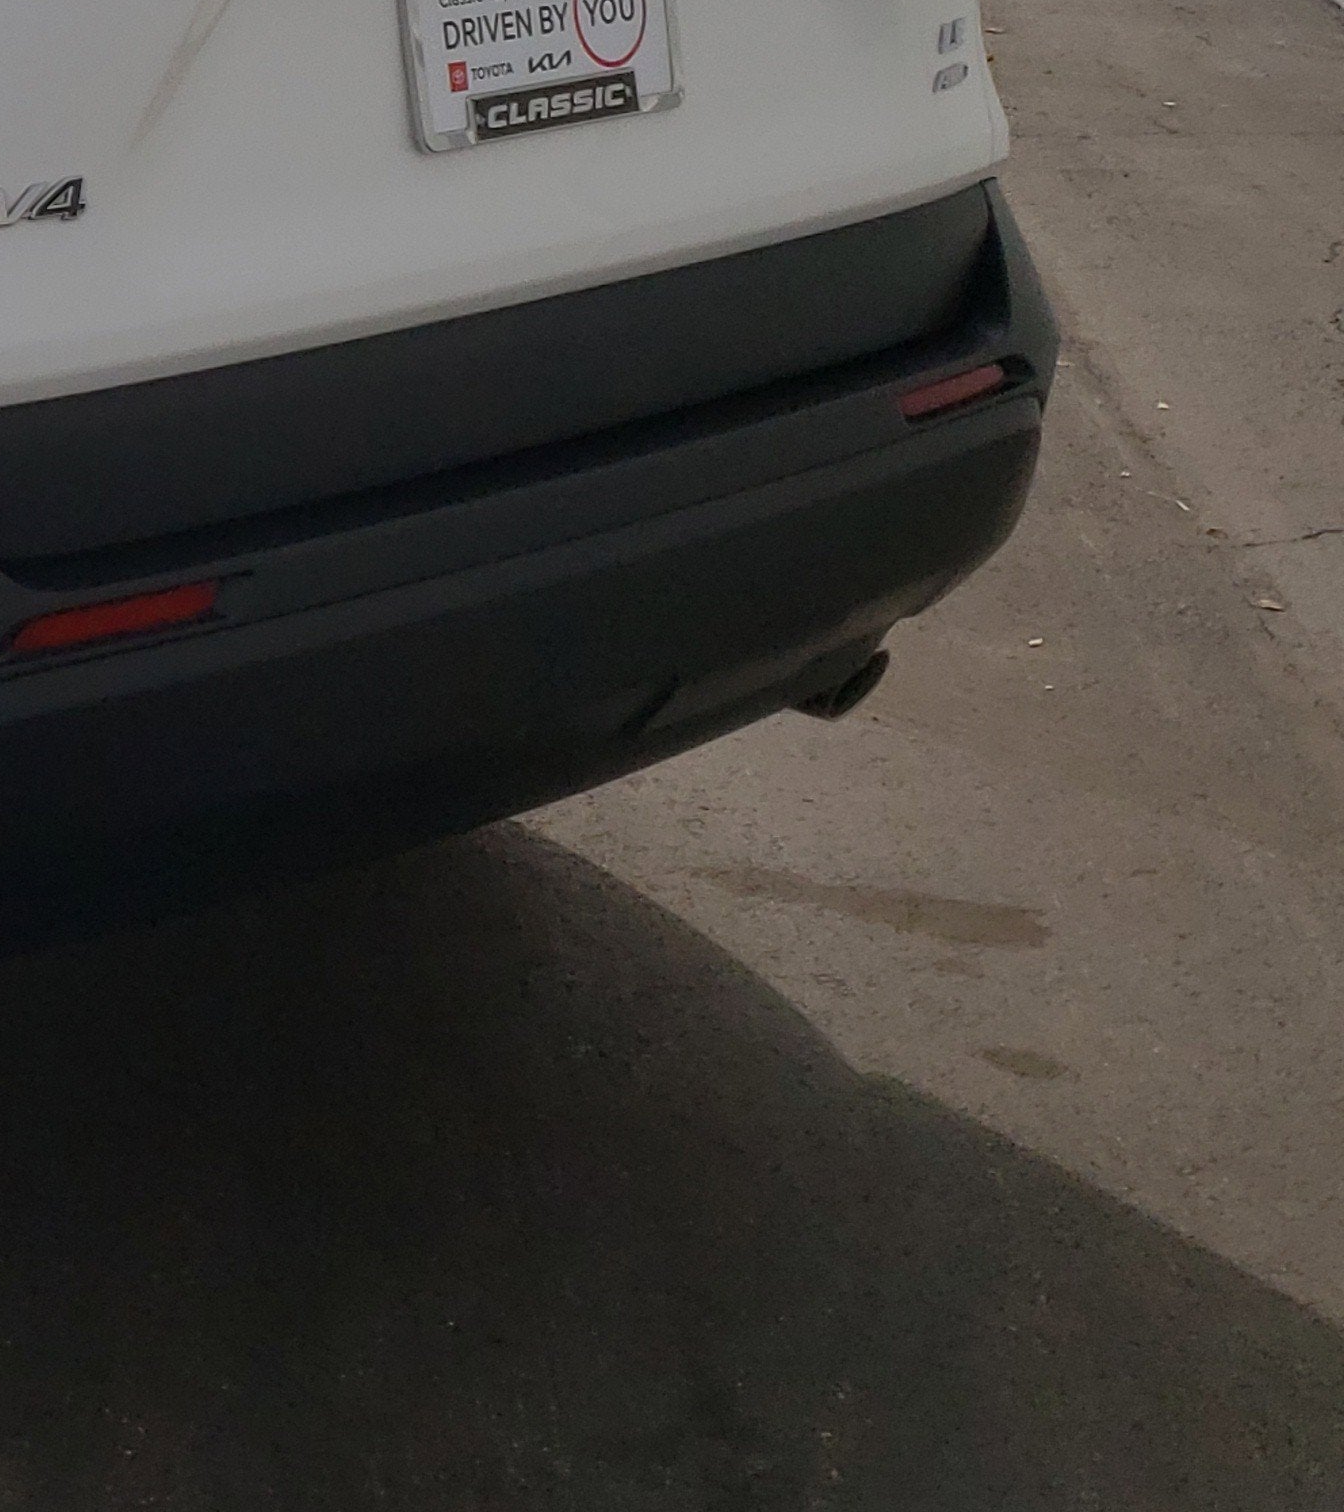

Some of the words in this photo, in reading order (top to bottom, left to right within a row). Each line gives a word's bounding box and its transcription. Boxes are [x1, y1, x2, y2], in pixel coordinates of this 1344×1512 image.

[443, 8, 533, 50] DRIVEN
[538, 1, 568, 35] BY
[470, 62, 514, 80] TOYOTA
[487, 83, 626, 129] CLASSIC
